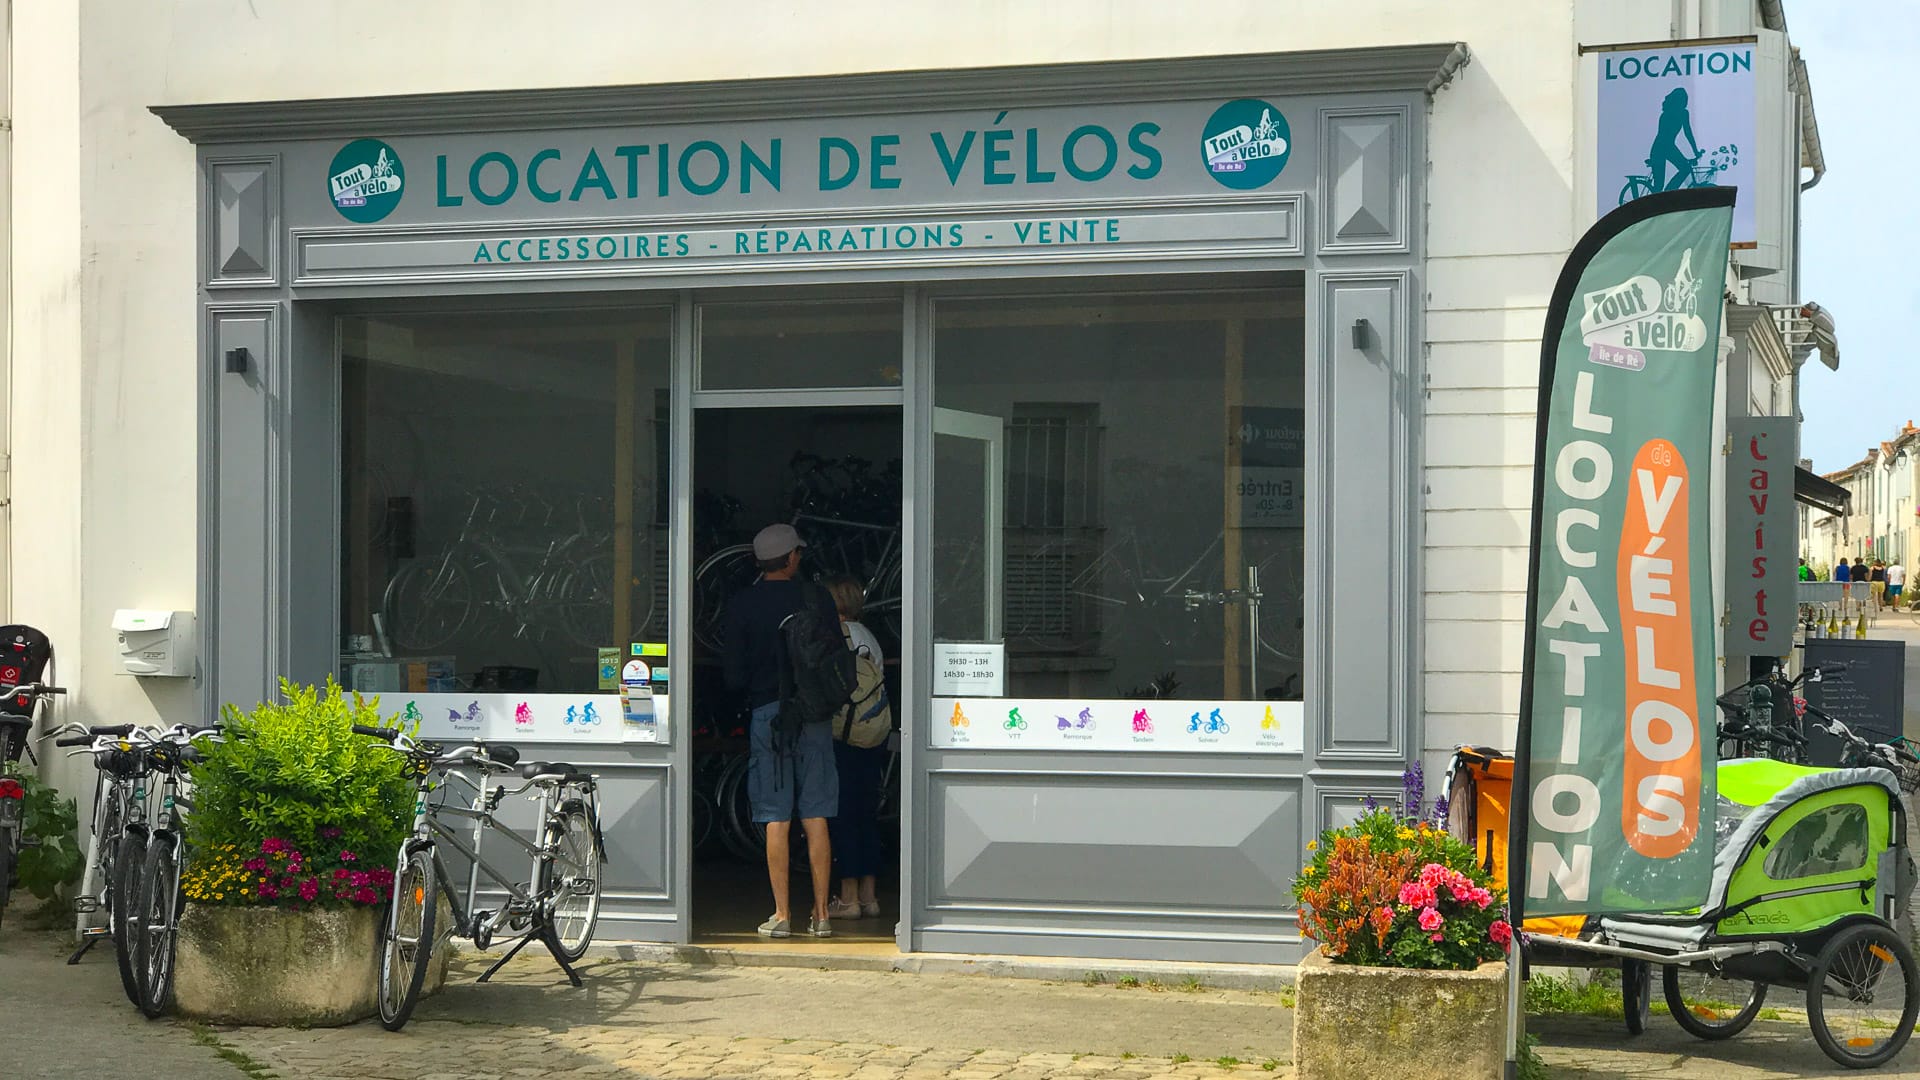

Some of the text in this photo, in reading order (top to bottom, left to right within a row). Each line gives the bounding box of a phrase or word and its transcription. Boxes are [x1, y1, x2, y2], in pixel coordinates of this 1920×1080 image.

[1605, 51, 1751, 80] LOCATION
[1209, 129, 1244, 154] Tout
[1239, 142, 1271, 160] vélo
[436, 111, 1163, 207] LOCATION DE VÉLOS
[334, 168, 365, 191] Tout
[473, 234, 691, 263] ACCESSOIRES
[735, 222, 964, 254] RÉPARATIONS
[1013, 219, 1121, 246] VENTE
[1591, 282, 1648, 325] Tout
[1623, 325, 1634, 347] à
[1637, 315, 1686, 349] vélo
[1613, 352, 1624, 364] de
[1651, 443, 1672, 467] de
[1528, 370, 1614, 902] LOCATION
[1629, 468, 1695, 838] VÉLOS
